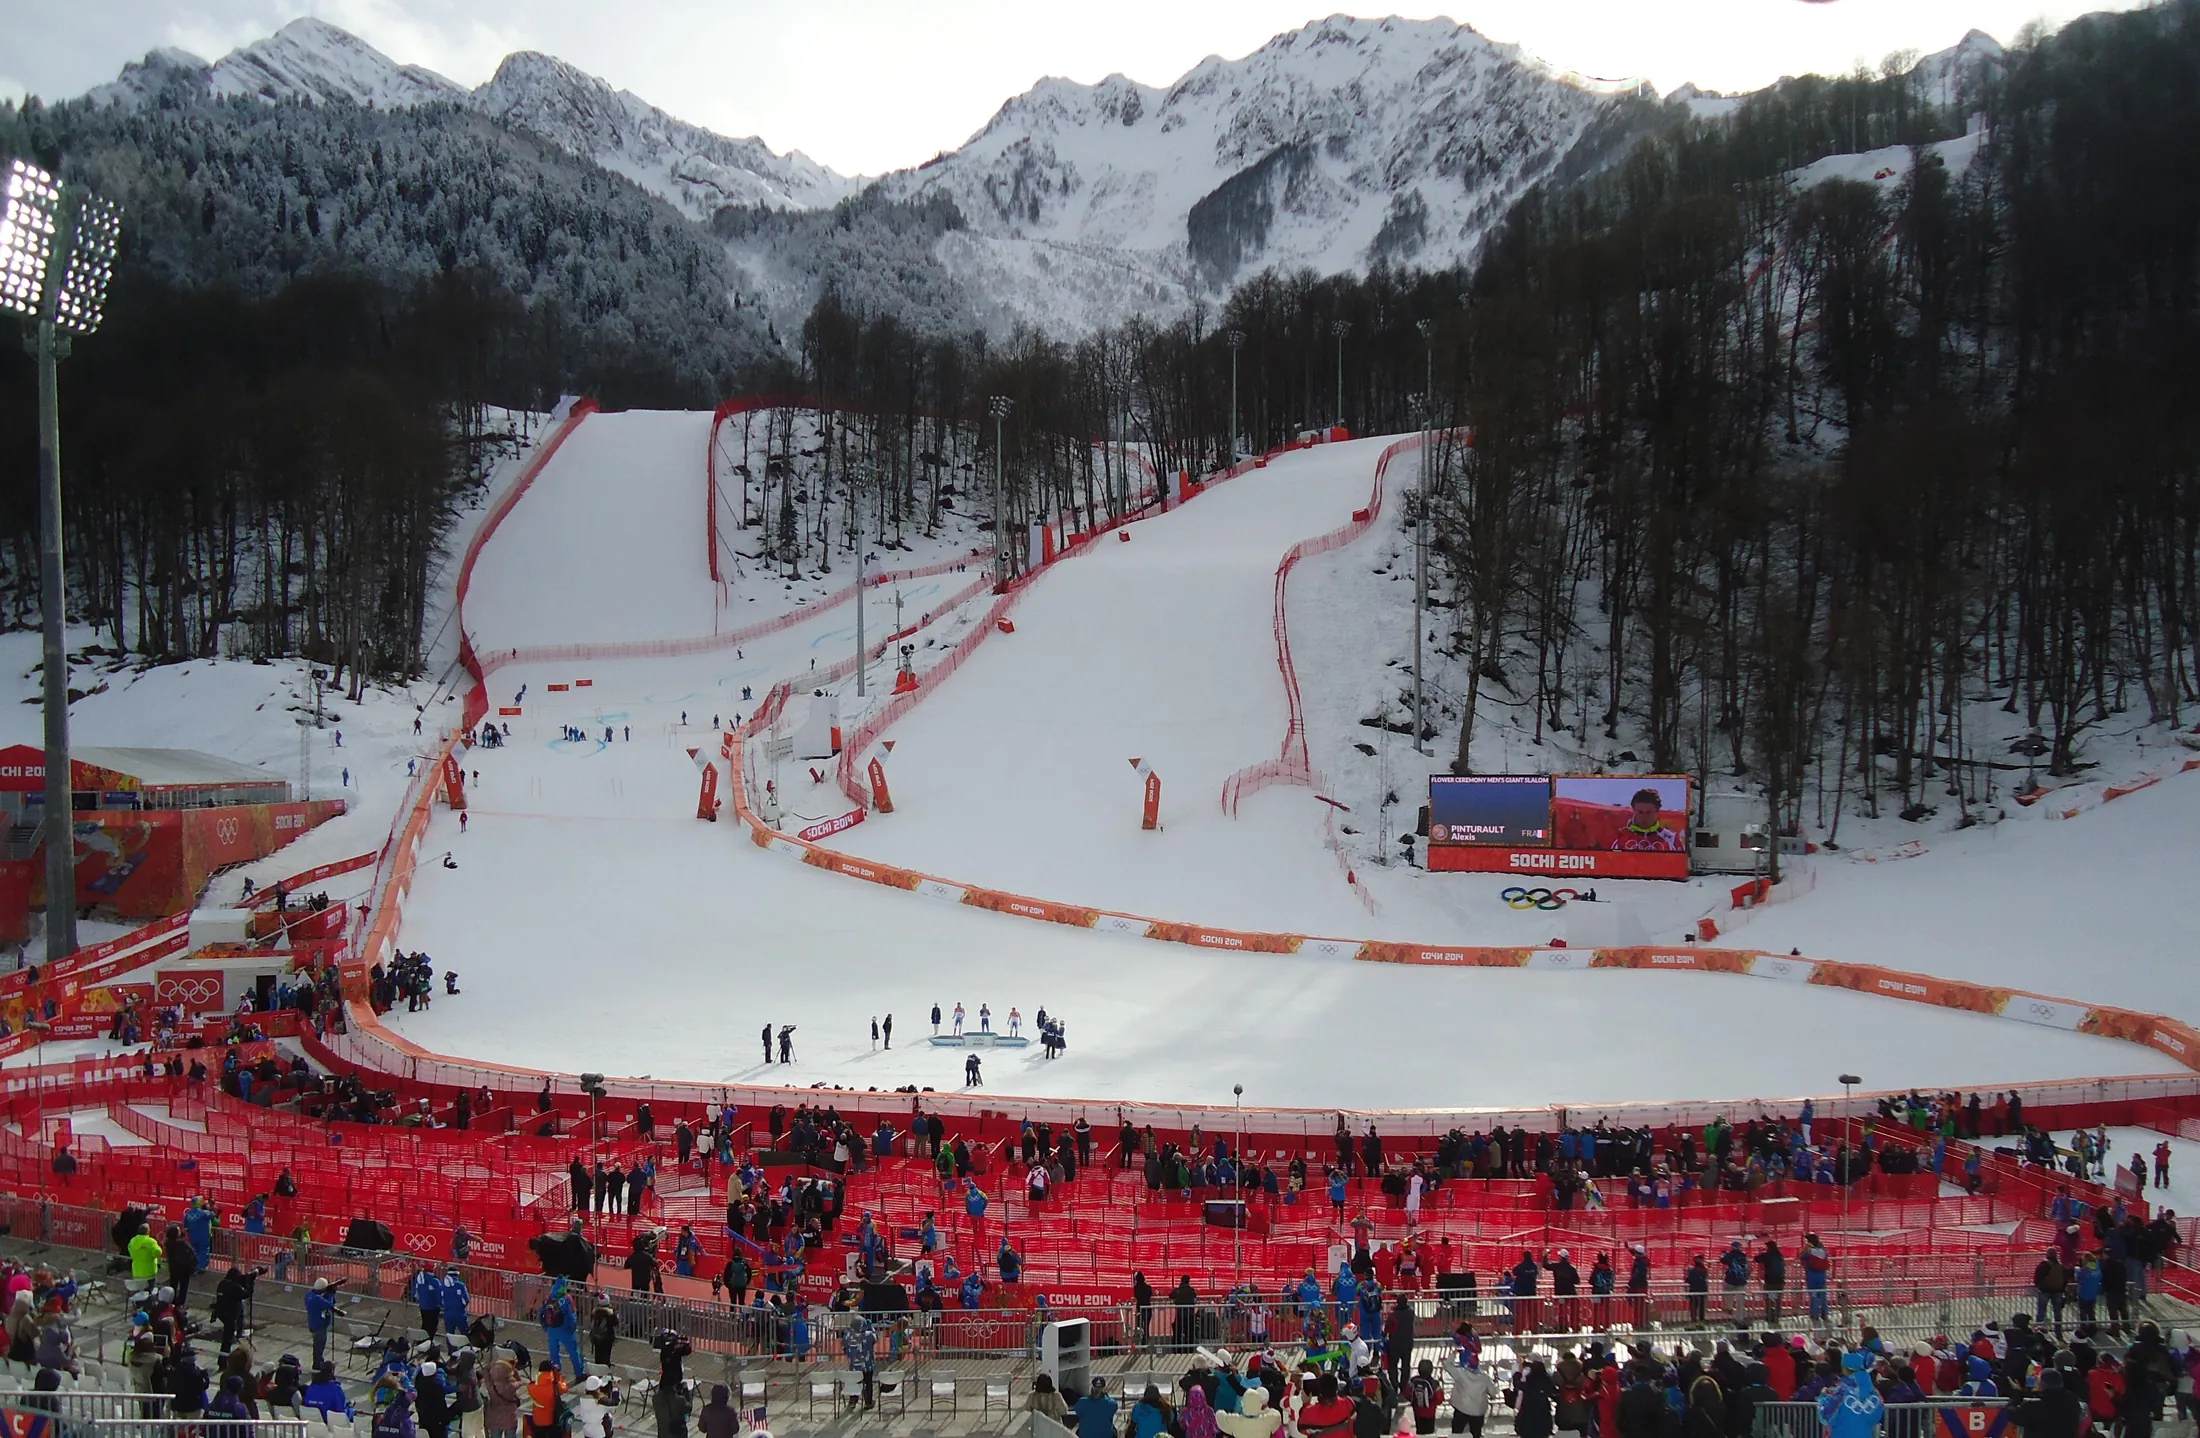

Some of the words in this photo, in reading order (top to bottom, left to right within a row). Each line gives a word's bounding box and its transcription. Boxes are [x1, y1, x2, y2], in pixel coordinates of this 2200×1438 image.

[0, 766, 22, 777] CHI
[25, 766, 46, 777] 201
[1455, 776, 1486, 784] CEREMONY
[1506, 776, 1524, 784] GIANT
[807, 821, 832, 839] SOCHI
[834, 815, 854, 831] 2014
[1451, 825, 1505, 833] PINTURAULT
[1451, 833, 1476, 841] Alexis
[1510, 853, 1555, 868] SOCHI
[1559, 855, 1595, 870] 2014
[842, 863, 860, 874] SOCHI
[860, 868, 875, 877] 2014
[1029, 906, 1045, 915] 2014
[1200, 934, 1224, 944] SOCHI
[1224, 937, 1243, 946] 2014
[1421, 951, 1443, 960] СОЧИ
[1444, 952, 1464, 961] 2014
[1651, 955, 1675, 964] SOCHI
[1676, 955, 1695, 964] 2014
[1904, 983, 1927, 996] 2014
[482, 1242, 504, 1253] 2014
[808, 1274, 833, 1286] 2014
[1049, 1293, 1081, 1305] СОЧИ
[1084, 1294, 1112, 1306] 2014
[13, 1414, 25, 1435] C
[1969, 1411, 1986, 1431] B
